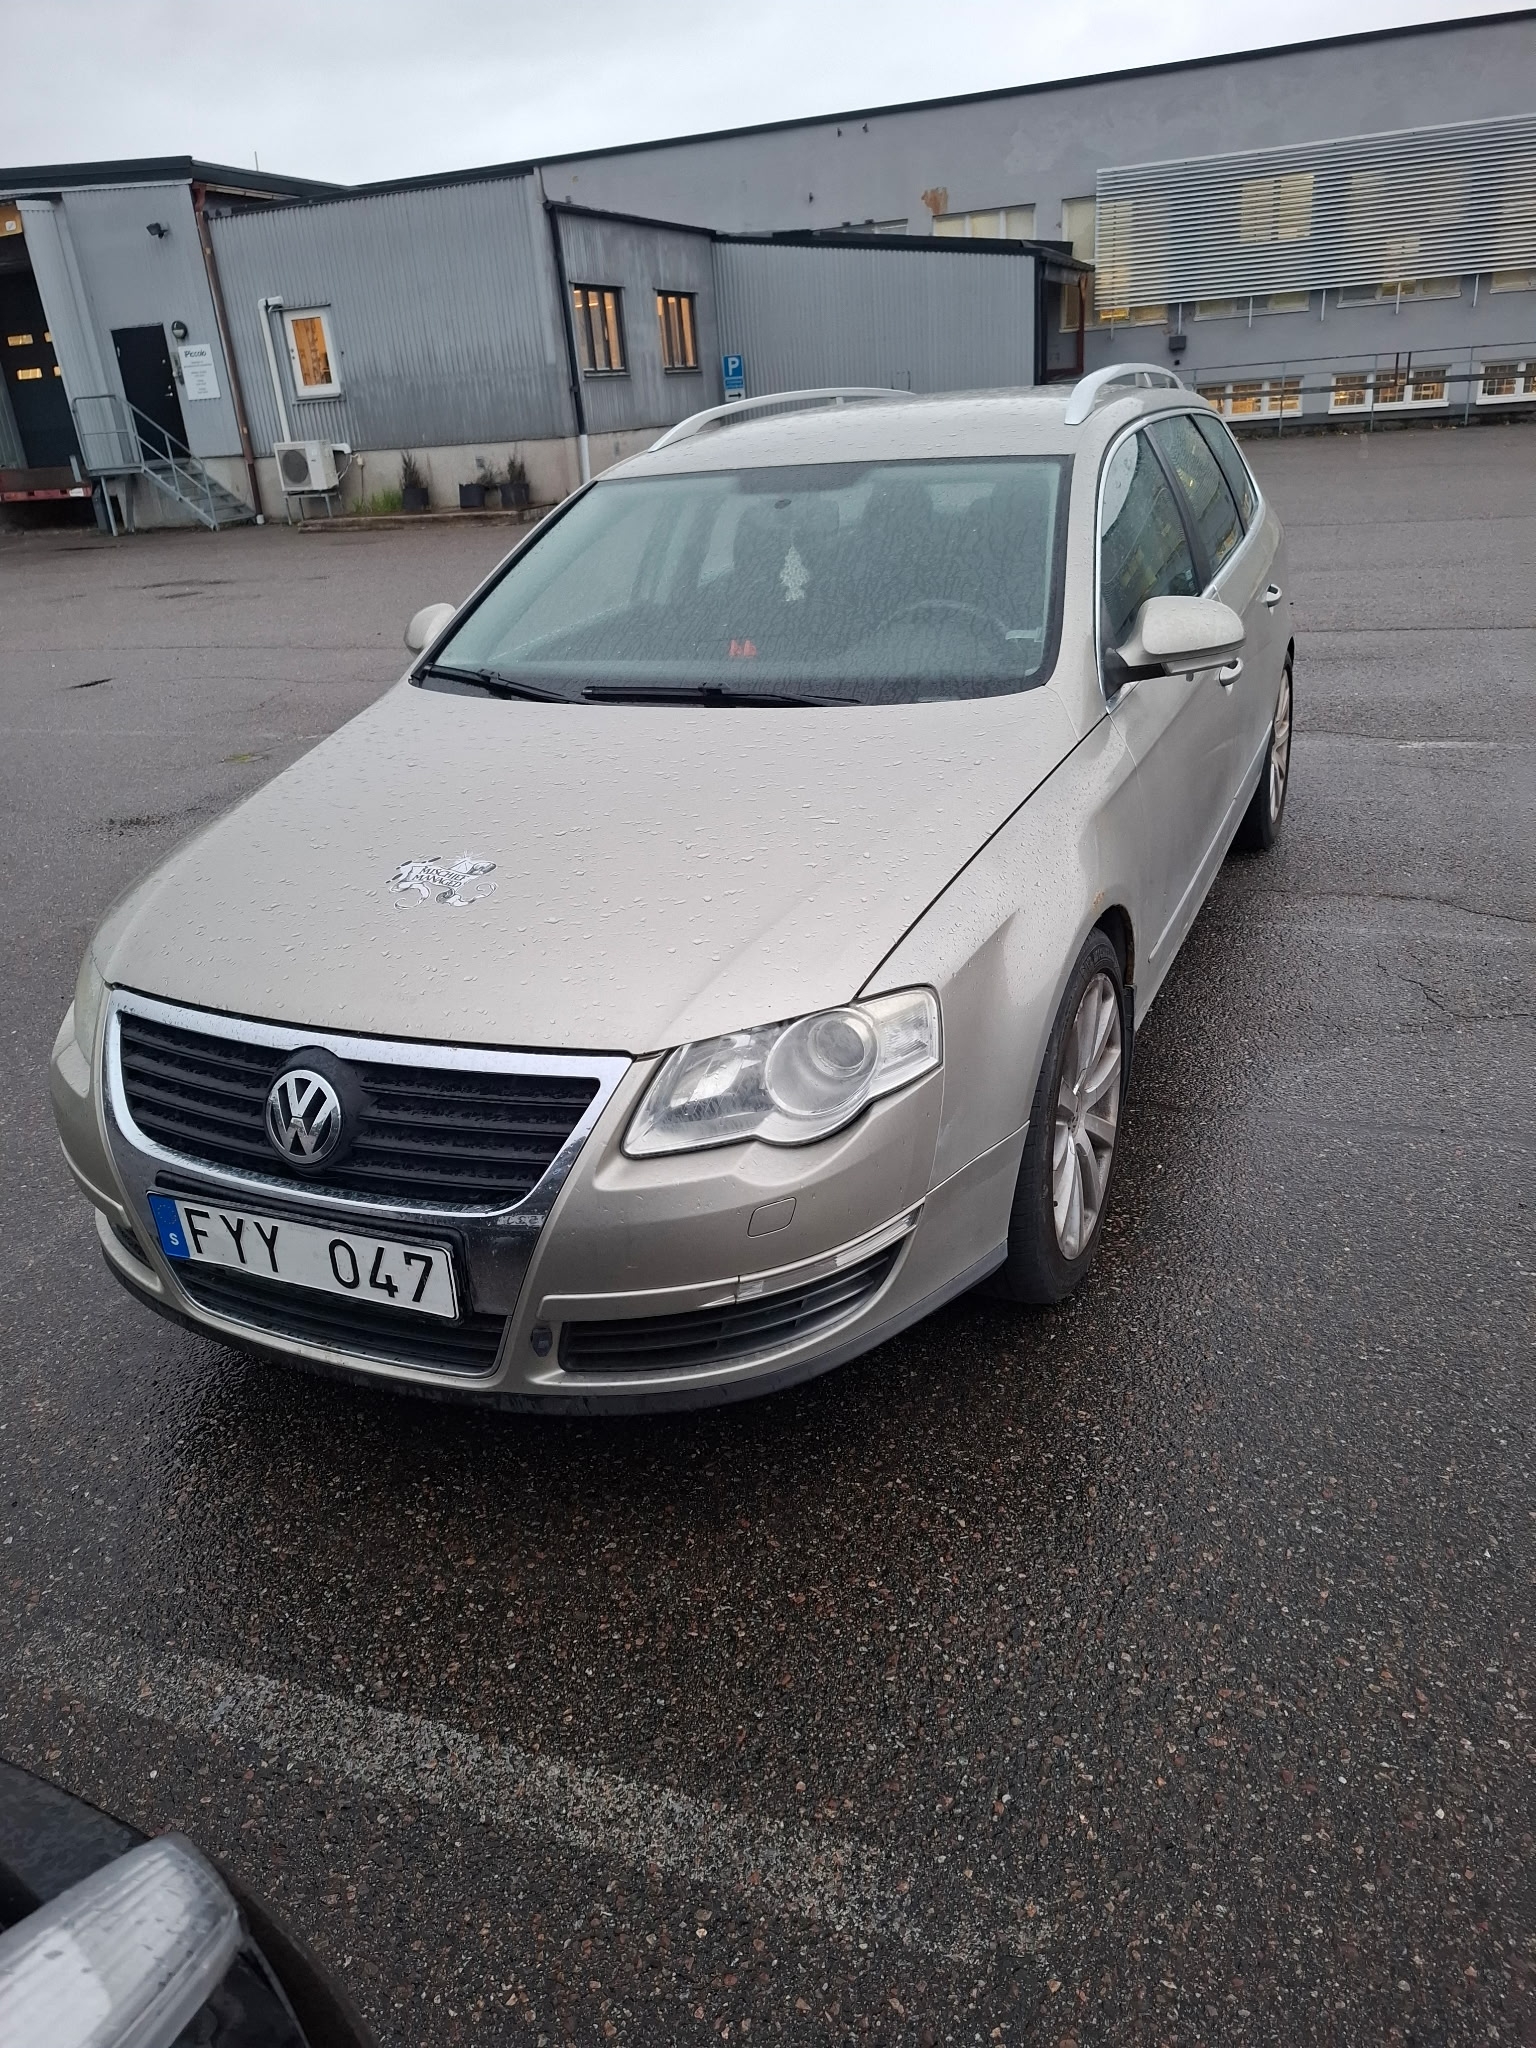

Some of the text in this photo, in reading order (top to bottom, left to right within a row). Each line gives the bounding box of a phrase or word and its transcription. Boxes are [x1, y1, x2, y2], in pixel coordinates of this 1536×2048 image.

[184, 349, 207, 358] Piccolo
[728, 357, 739, 376] P
[412, 874, 462, 887] MANAGED
[420, 866, 466, 881] MISCHIEF
[266, 1069, 341, 1165] VW
[169, 1231, 180, 1247] S
[184, 1207, 434, 1303] FYY 047
